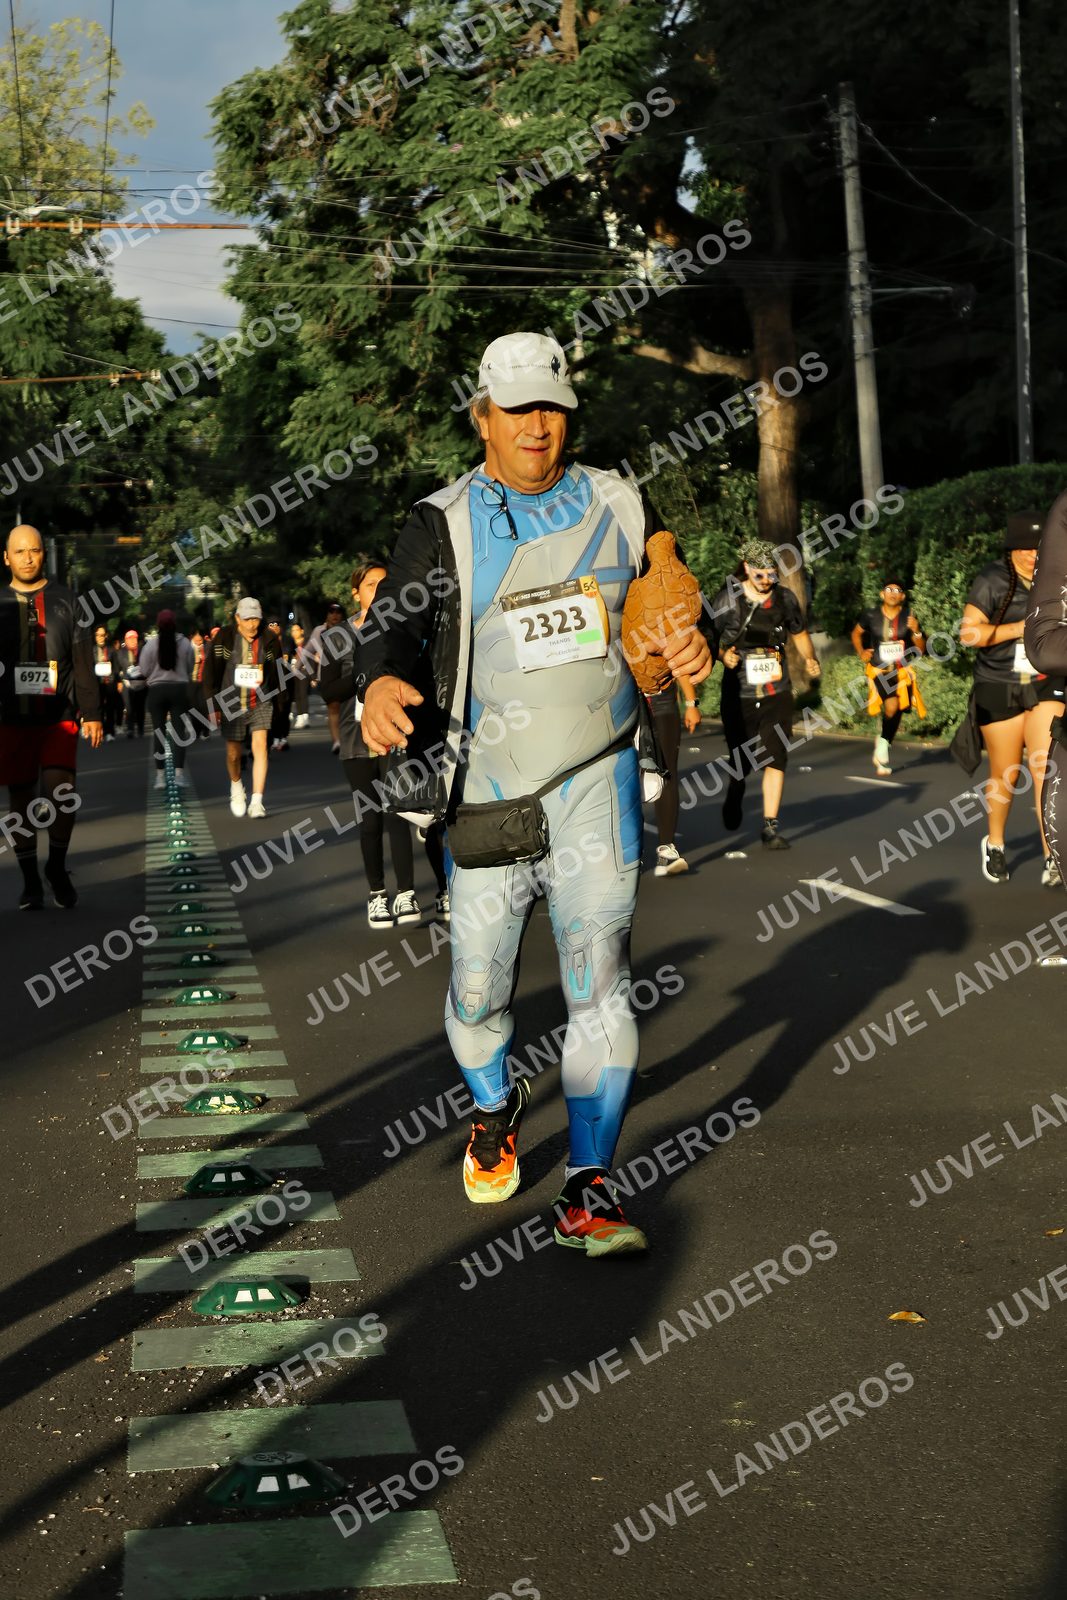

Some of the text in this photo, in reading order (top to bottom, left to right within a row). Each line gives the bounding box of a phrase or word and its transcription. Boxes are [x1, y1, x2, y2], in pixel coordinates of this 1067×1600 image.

[520, 605, 587, 643] 2323
[752, 662, 775, 673] 4487
[20, 671, 49, 682] 6972
